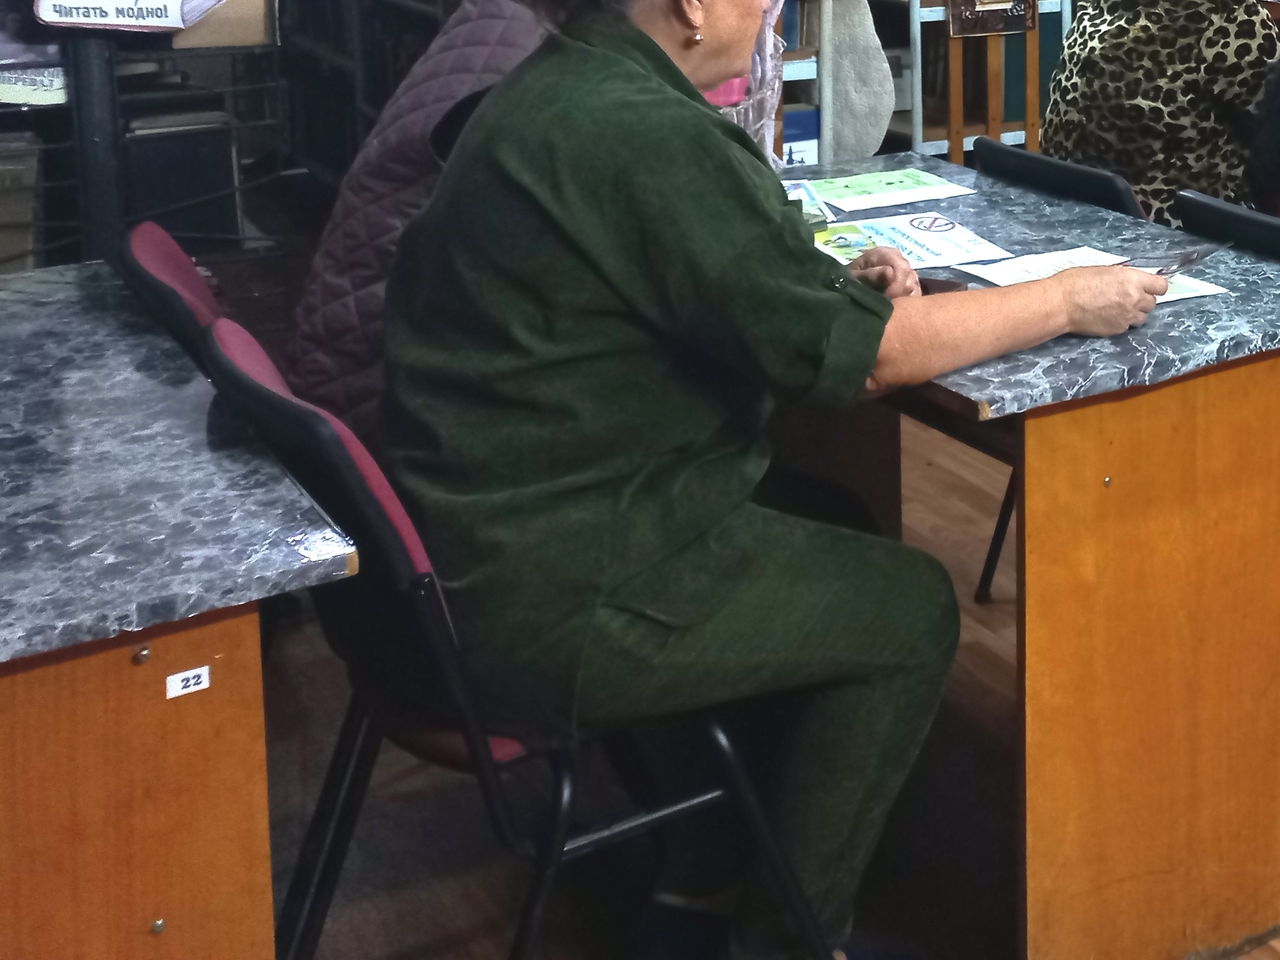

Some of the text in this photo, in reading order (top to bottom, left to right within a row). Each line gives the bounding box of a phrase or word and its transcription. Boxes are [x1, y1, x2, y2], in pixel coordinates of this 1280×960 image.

[53, 3, 169, 21] Читать модно!
[180, 673, 204, 690] 22
